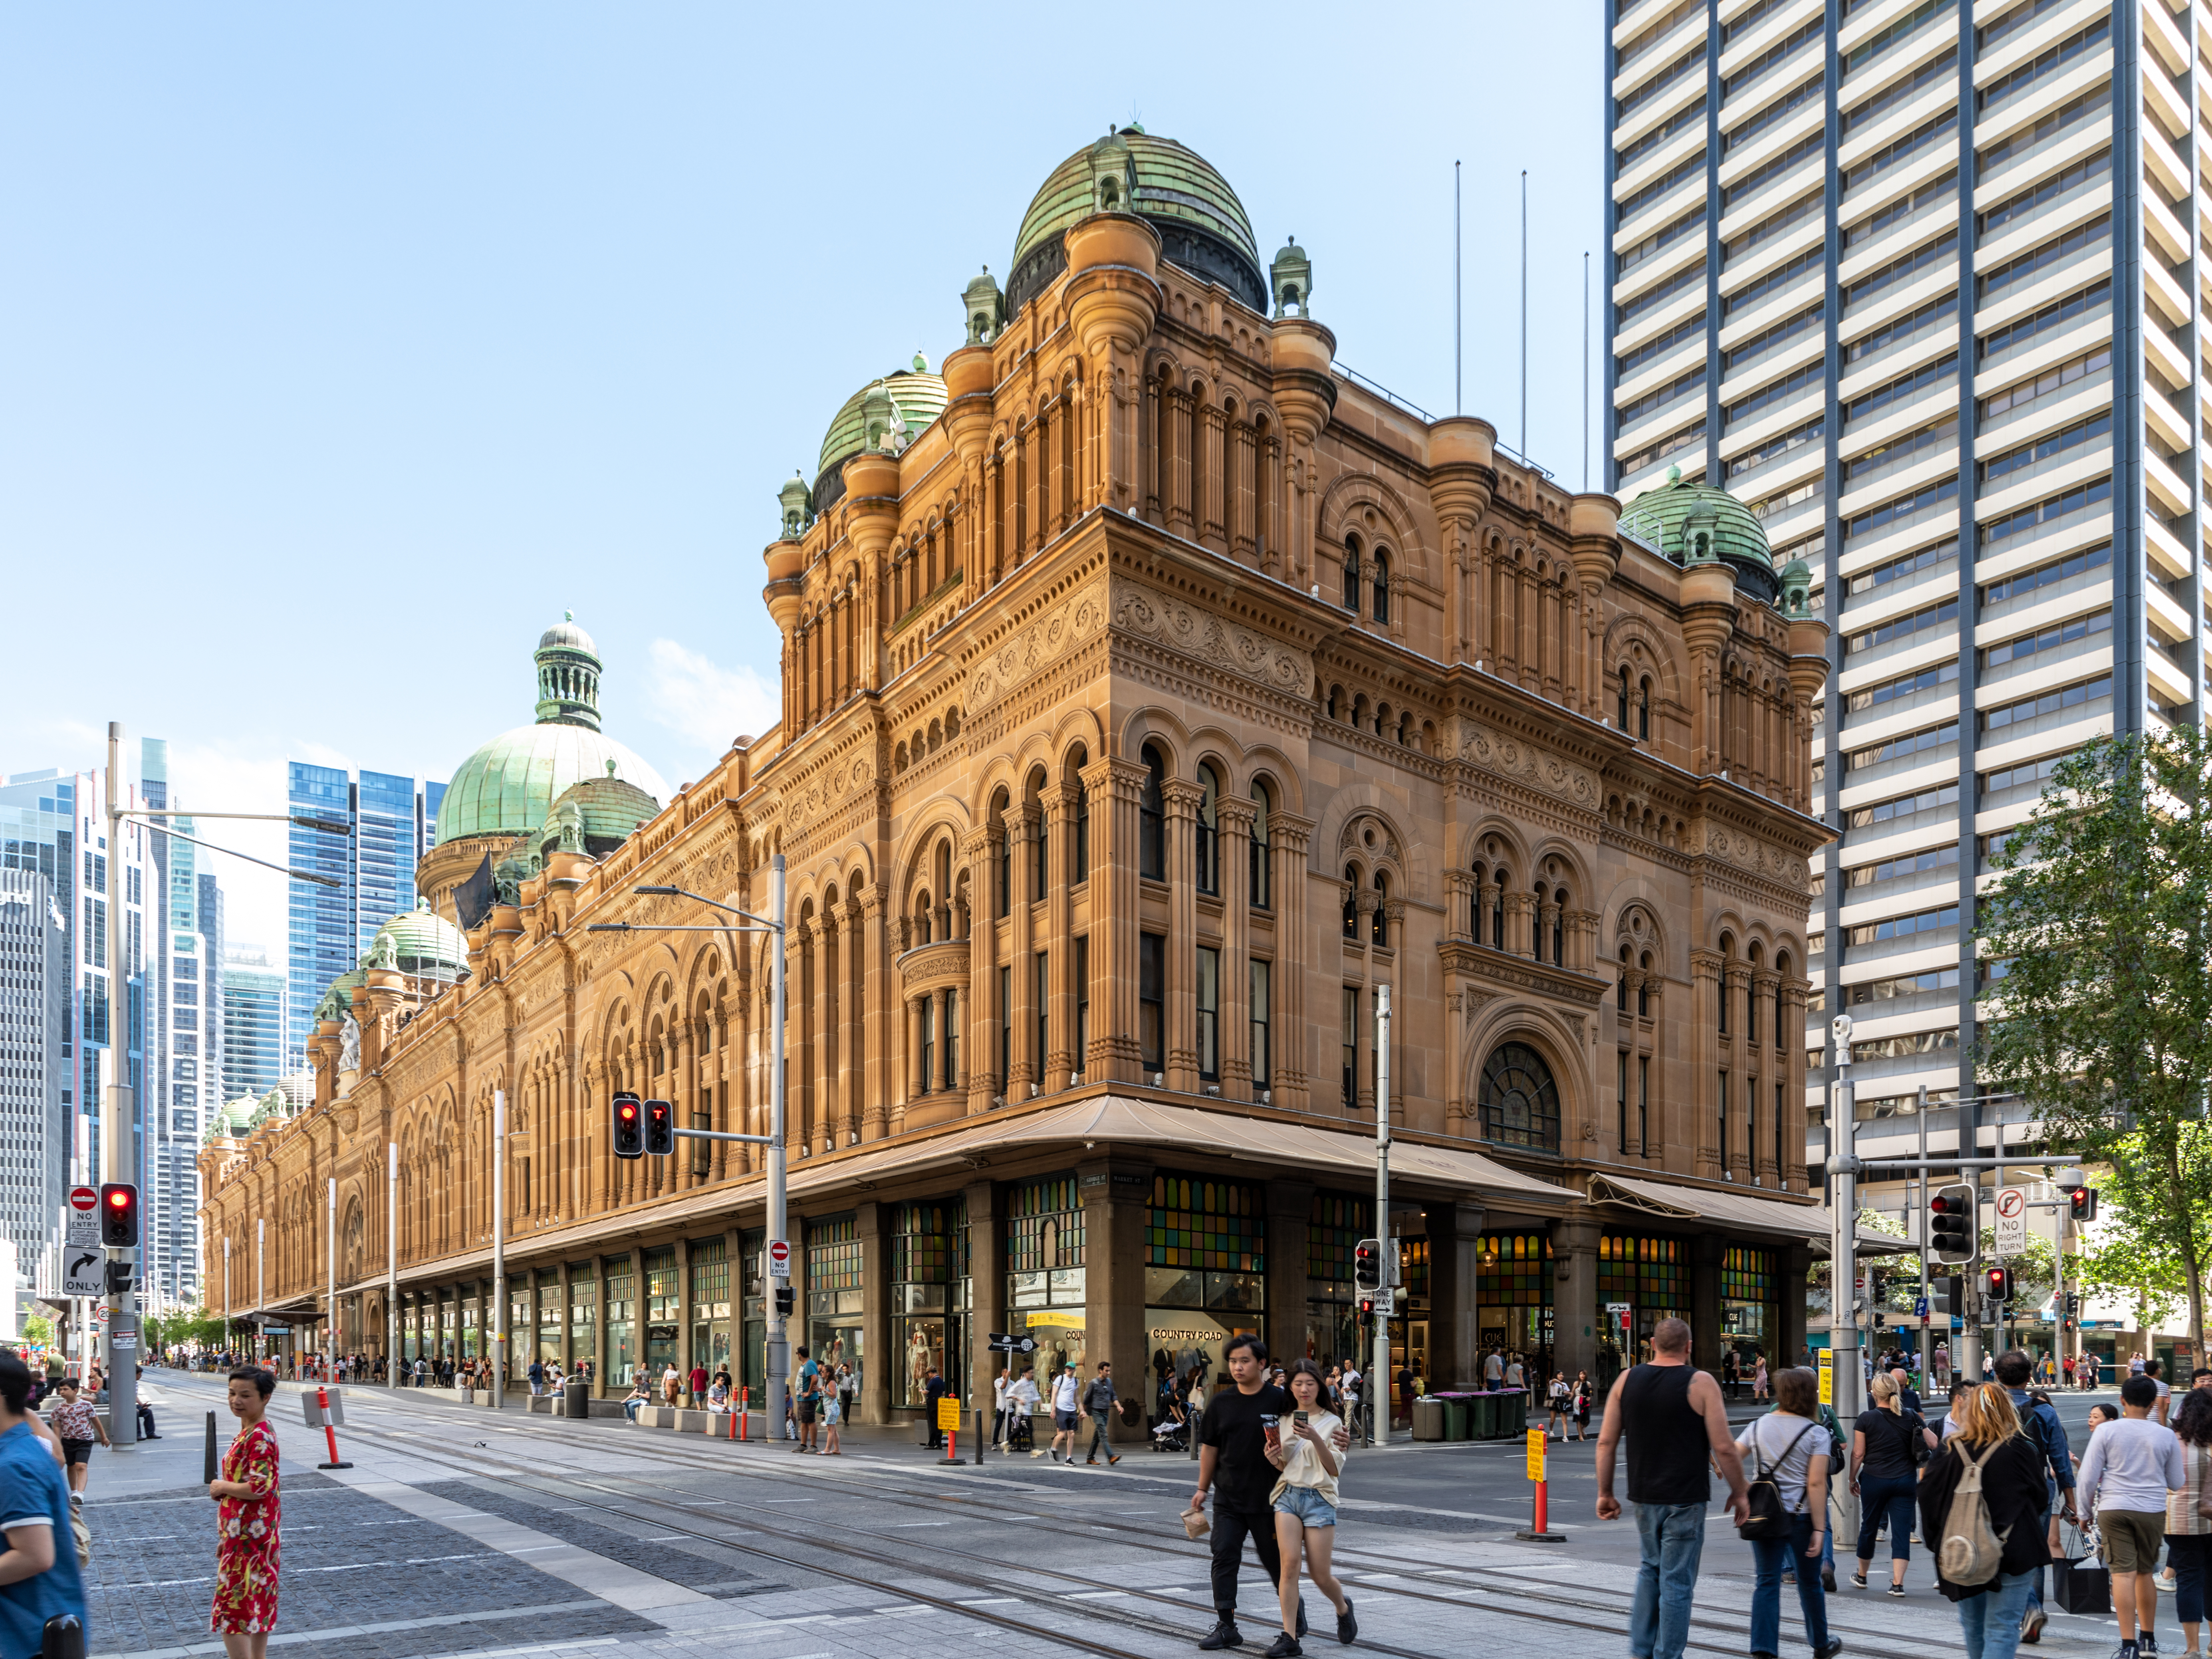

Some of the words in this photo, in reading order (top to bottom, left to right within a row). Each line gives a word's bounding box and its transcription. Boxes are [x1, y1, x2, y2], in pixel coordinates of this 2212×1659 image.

[2002, 1220, 2018, 1231] NO
[1998, 1233, 2022, 1241] RIGHT
[66, 1281, 101, 1291] ONLY
[1153, 1329, 1196, 1340] COUNTRY
[1198, 1331, 1222, 1340] ROAD
